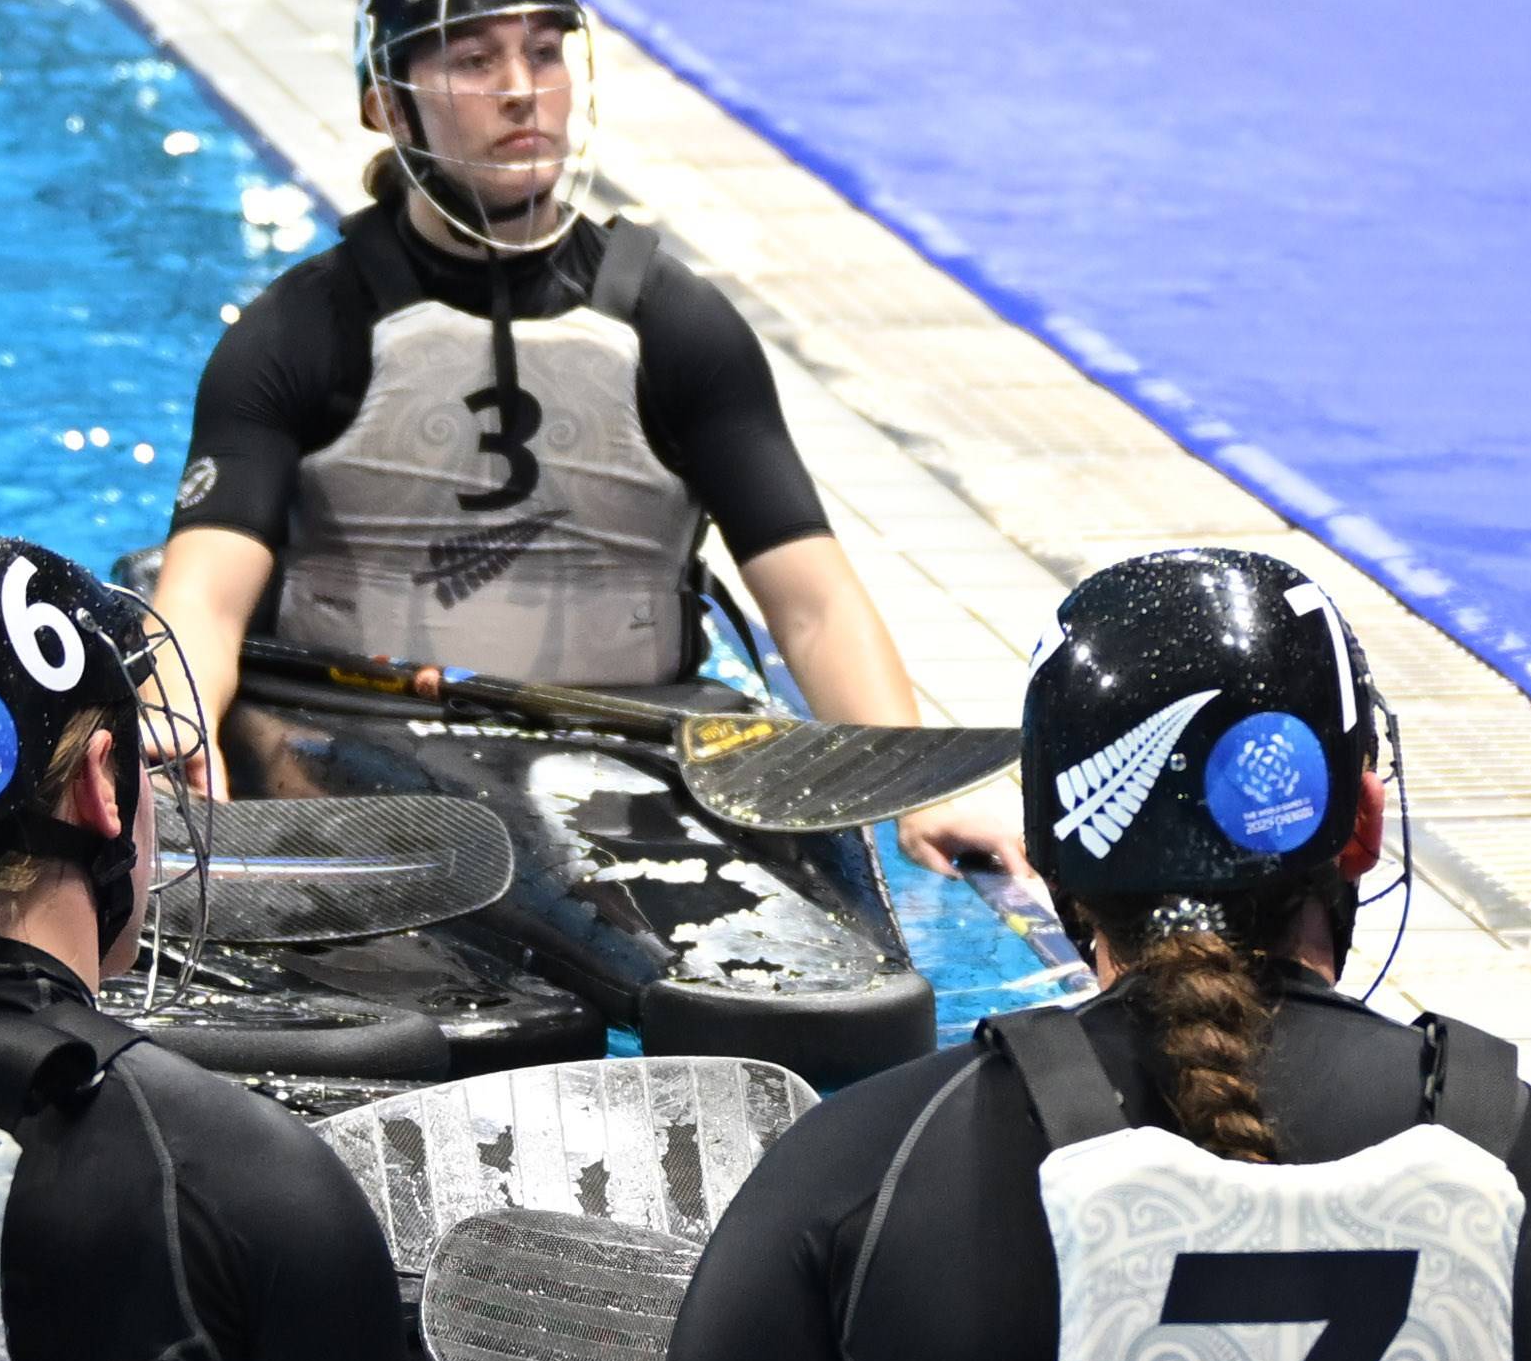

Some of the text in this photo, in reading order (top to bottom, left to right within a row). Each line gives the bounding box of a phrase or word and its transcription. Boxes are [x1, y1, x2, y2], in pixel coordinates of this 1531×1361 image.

[457, 387, 542, 511] 3
[1, 556, 85, 692] 6
[1283, 582, 1358, 733] 7
